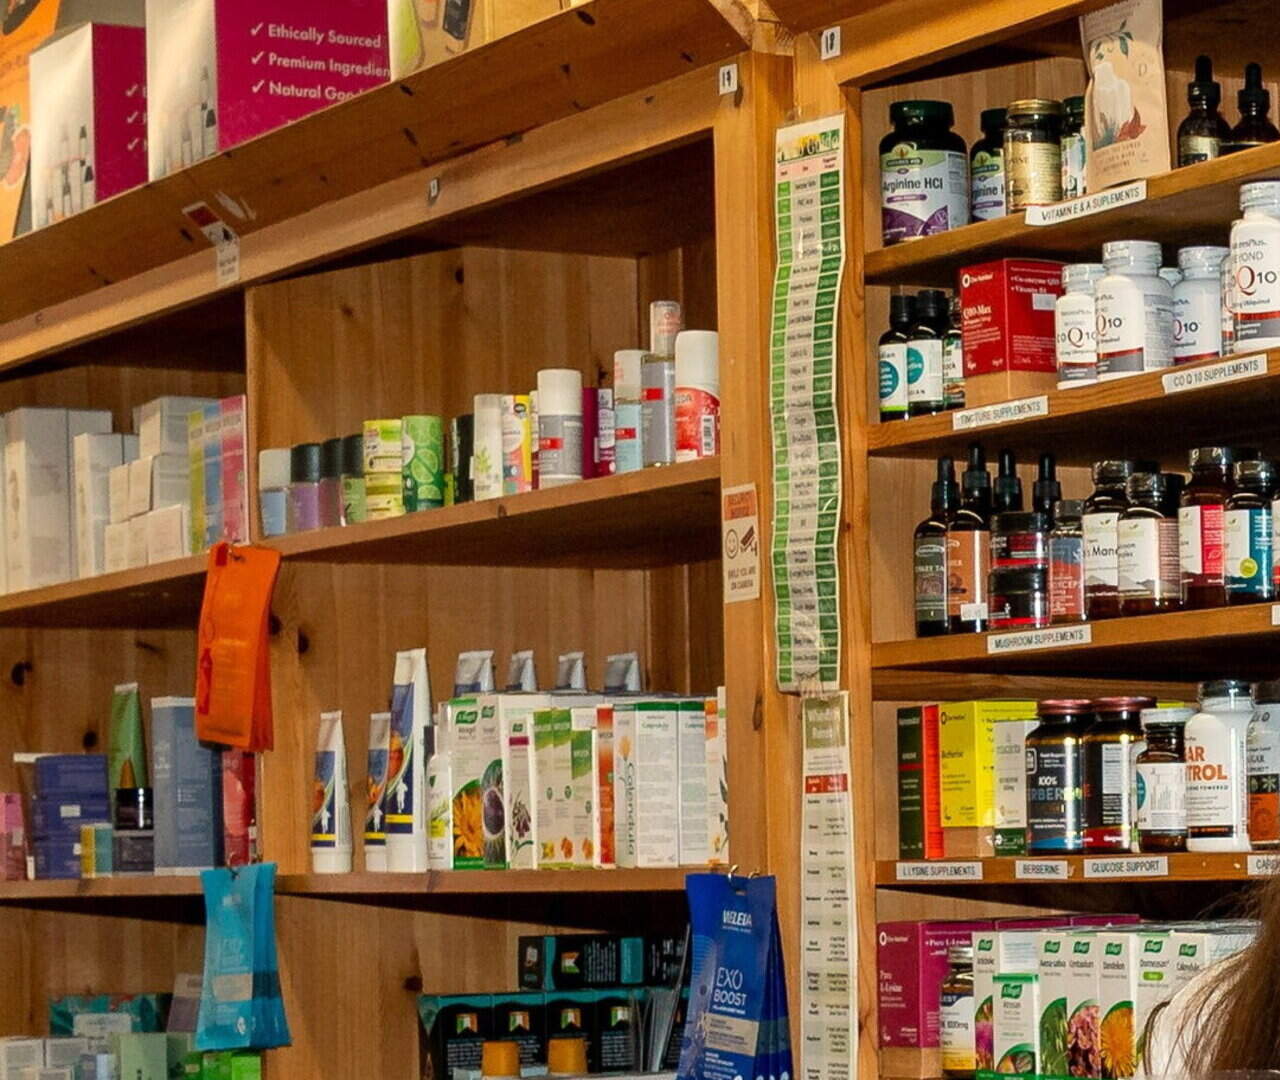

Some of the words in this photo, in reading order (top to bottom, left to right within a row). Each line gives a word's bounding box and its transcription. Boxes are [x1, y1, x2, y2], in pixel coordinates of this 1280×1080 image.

[268, 24, 324, 42] Ethically
[327, 30, 381, 49] Sourced
[269, 54, 324, 71] Premium
[329, 58, 391, 76] Ingredien
[270, 82, 321, 98] Natural
[993, 402, 1040, 421] SUPPLEMENTS
[995, 636, 1033, 650] MUSHROOM
[1034, 630, 1084, 645] SUPPLEMENTS
[929, 865, 975, 876] SUPPLEMENTS
[1091, 862, 1124, 873] GLUCOSE
[1126, 860, 1160, 872] SUPPORT
[716, 967, 744, 990] EXO
[713, 990, 747, 1006] BOOST
